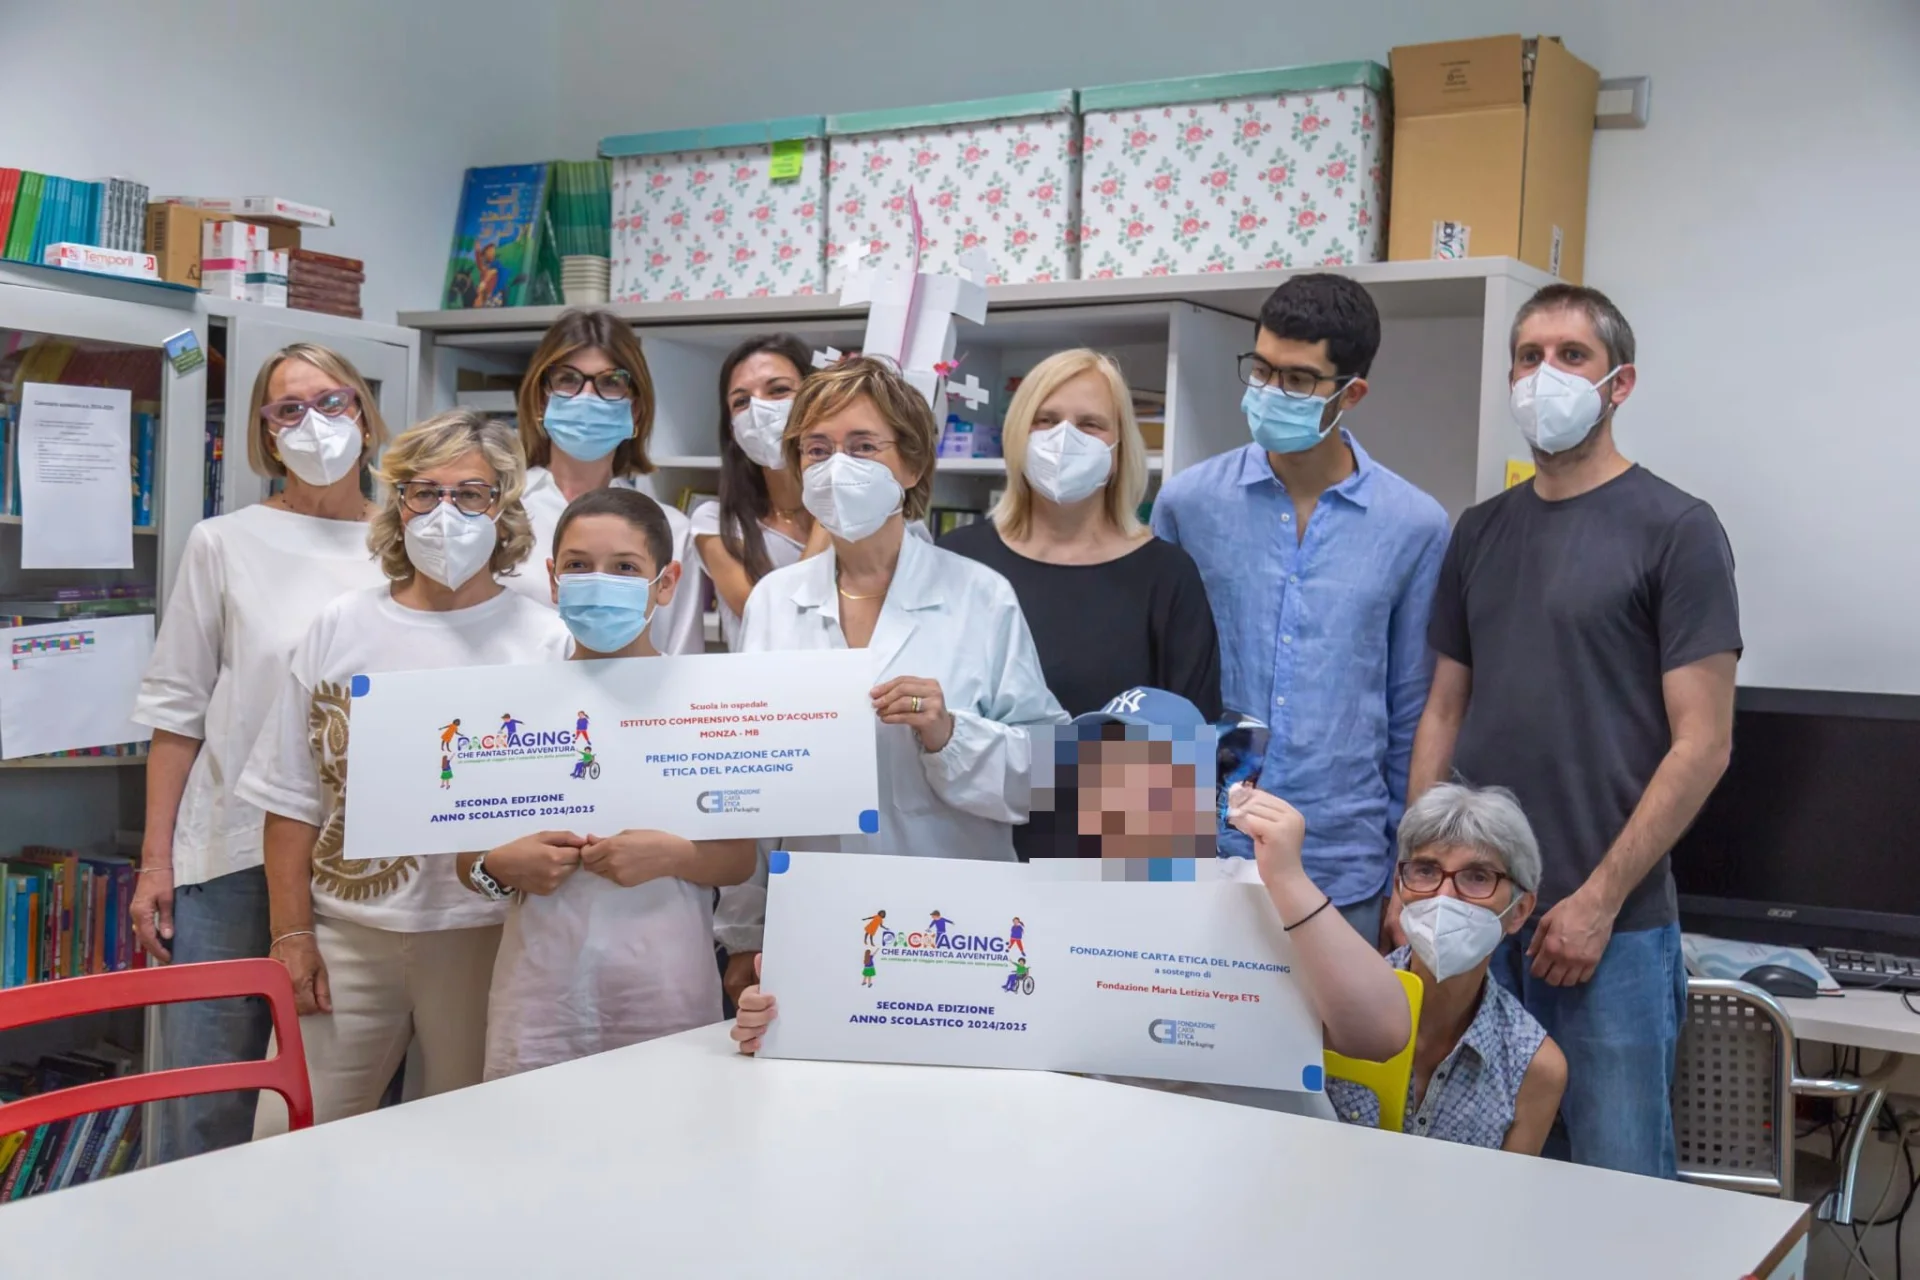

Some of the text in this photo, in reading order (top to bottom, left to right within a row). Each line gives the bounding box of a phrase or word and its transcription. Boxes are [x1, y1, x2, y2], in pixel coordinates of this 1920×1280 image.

[690, 702, 718, 710] Scuola
[730, 700, 768, 710] ospedale
[620, 712, 838, 728] ISTITUTO COMPRENSIVO SALVO D'ACQUISTO
[700, 729, 737, 738] MONZA
[745, 729, 759, 737] MB
[476, 749, 524, 757] FANTASTICA
[527, 746, 576, 754] AVVENTURA
[646, 749, 810, 764] PREMIO FONDAZIONE CARTA
[663, 764, 793, 777] ETICA DEL PACKAGING
[455, 794, 564, 808] SECONDA EDIZIONE
[430, 805, 595, 822] ANNO SCOLASTICO 2024/2025
[901, 949, 954, 958] FANTASTICA
[956, 952, 1009, 962] AVVENTURA
[1070, 946, 1291, 973] FONDAZIONE CARTA ETICA DEL PACKAGING
[1162, 969, 1200, 979] sostegno
[1203, 970, 1212, 979] di
[1096, 981, 1260, 1003] Fondazione Maria Letizia Verga ETS
[876, 1001, 995, 1015] SECONDA EDIZIONE
[849, 1015, 1028, 1031] ANNO SCOLASTICO 2024/2025
[1178, 1020, 1216, 1029] FONDAZIONE
